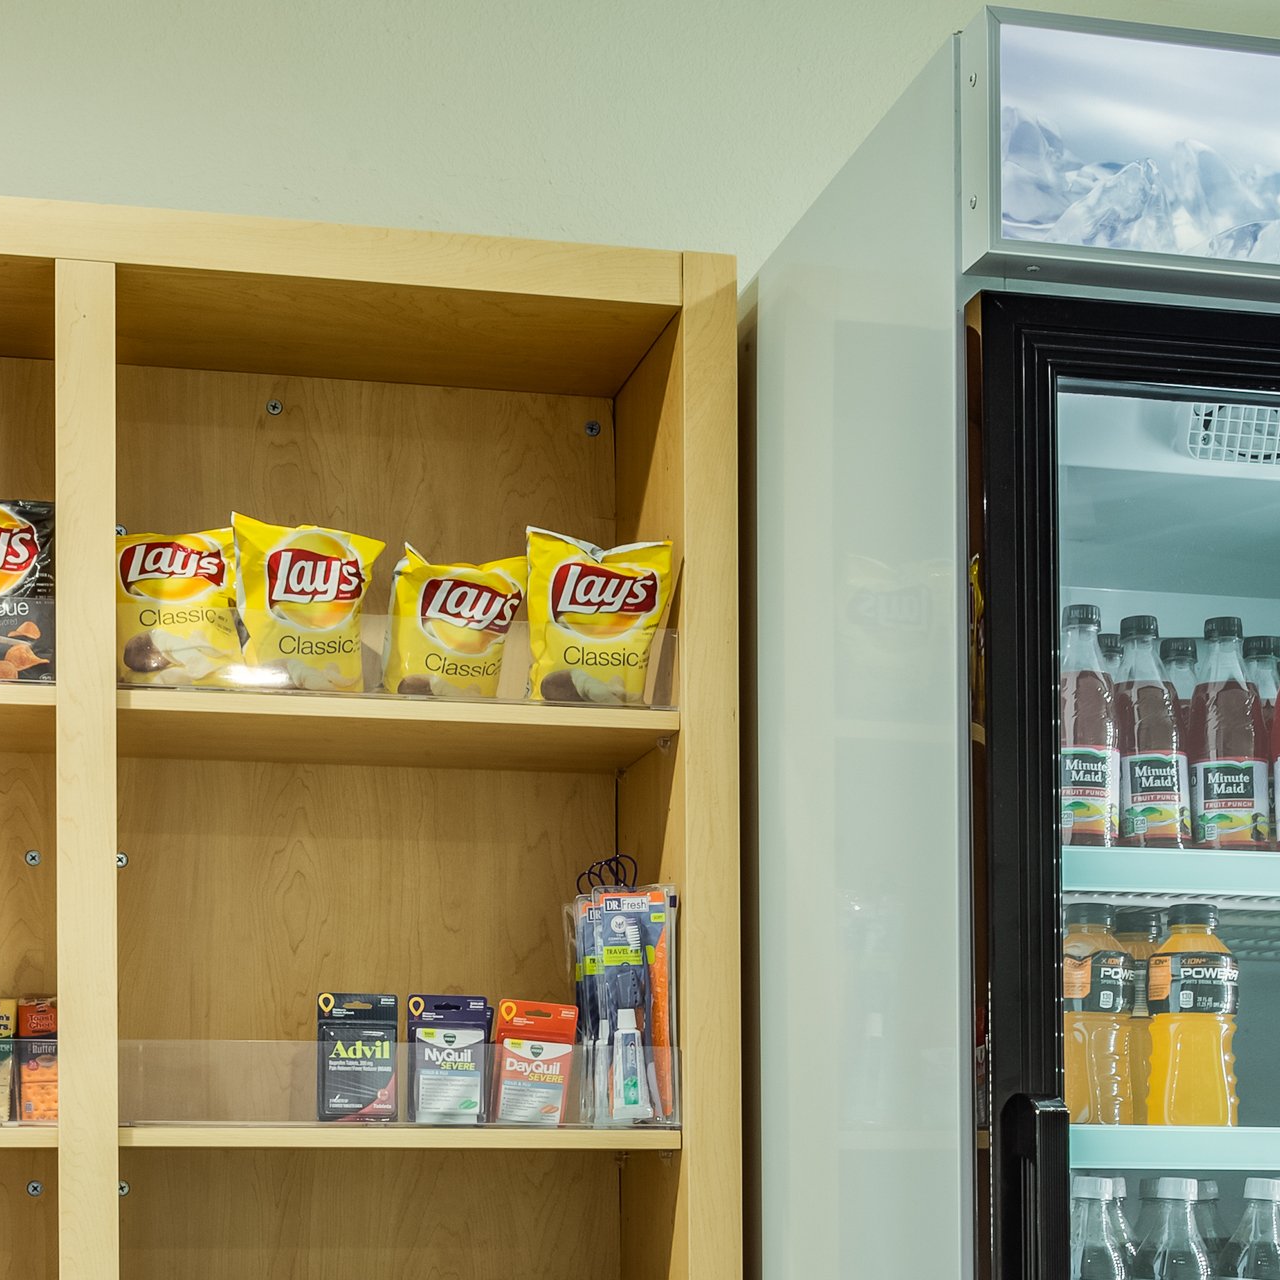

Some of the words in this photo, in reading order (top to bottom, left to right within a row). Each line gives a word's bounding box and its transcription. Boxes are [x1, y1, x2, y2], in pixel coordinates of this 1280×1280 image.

[128, 544, 219, 582] Lay's
[272, 552, 359, 603] Lay's
[557, 565, 654, 613] Lay's
[425, 580, 519, 630] Lay's
[139, 606, 216, 627] Classic
[279, 635, 353, 655] Classic
[564, 646, 638, 666] Classic
[425, 653, 495, 678] Classic
[1071, 771, 1102, 782] Maid
[1208, 772, 1250, 783] Minute
[1213, 784, 1244, 794] Maid
[622, 898, 647, 910] Fresh
[28, 1014, 55, 1023] Toast
[28, 1021, 54, 1030] Chee
[329, 1040, 390, 1059] Advil
[425, 1049, 471, 1063] NyQuil
[440, 1062, 476, 1071] SEVERE
[505, 1058, 561, 1075] DayQuil
[528, 1073, 564, 1083] SEVERE
